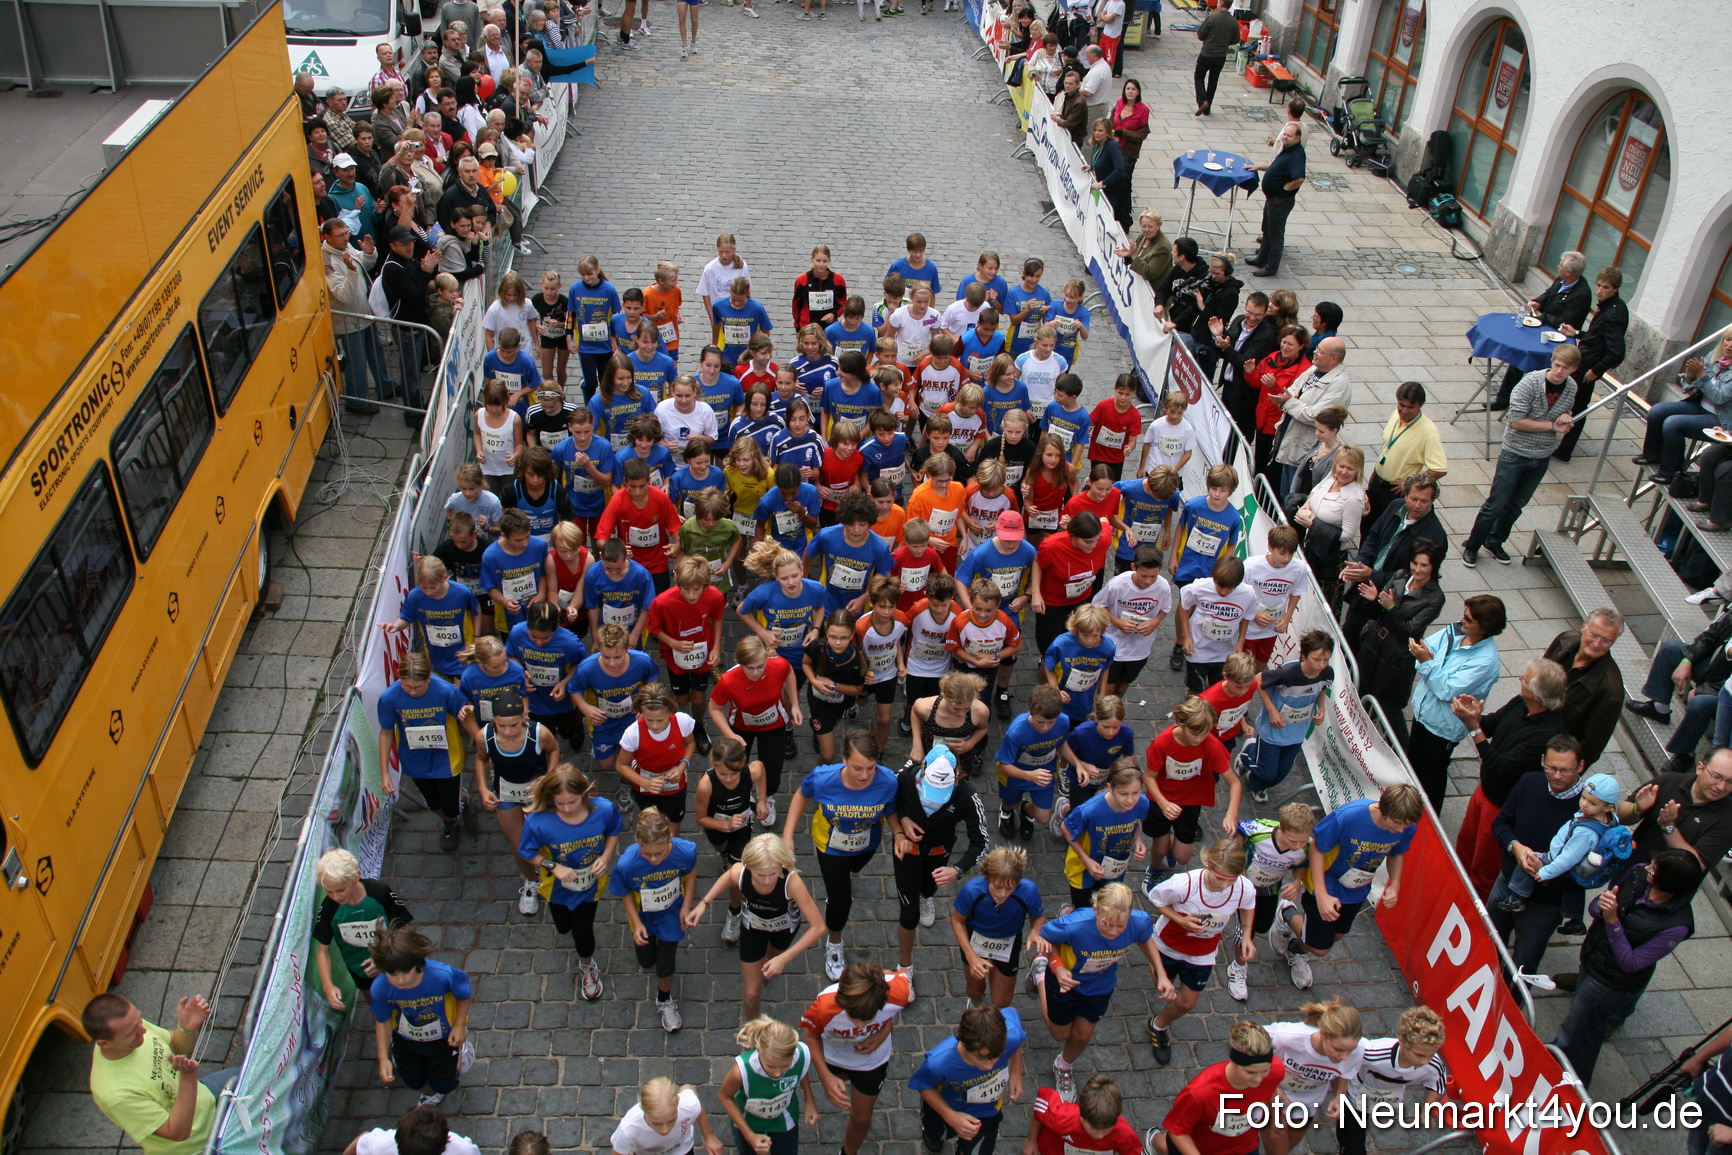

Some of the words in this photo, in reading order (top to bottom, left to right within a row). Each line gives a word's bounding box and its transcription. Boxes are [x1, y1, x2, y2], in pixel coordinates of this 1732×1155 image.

[1623, 161, 1640, 177] NEU
[1620, 172, 1636, 186] MARKT
[207, 208, 235, 254] EVENT
[234, 164, 265, 217] SERVICE
[120, 343, 134, 362] Fon:
[31, 373, 111, 496] SPORTRONIC
[40, 463, 71, 511] ELECTRONIC
[71, 436, 89, 465] SPORTS
[89, 397, 114, 438] EQUIPMENT
[637, 533, 657, 542] 4074
[1196, 540, 1215, 550] 4124
[512, 582, 533, 593] 4046
[1254, 580, 1288, 589] GERHART
[1117, 599, 1152, 608] GERHART
[1200, 602, 1234, 612] GERHART
[777, 606, 813, 615] NEUMARKTER
[780, 632, 802, 641] 4030
[684, 652, 706, 662] 4043
[1363, 740, 1373, 752] 52
[1174, 766, 1198, 775] 4041
[837, 804, 885, 813] NEUMARKTER
[842, 837, 867, 845] 4167
[654, 887, 677, 903] 4084
[355, 930, 376, 939] 410
[982, 941, 1009, 951] 4087
[408, 1029, 437, 1037] 4018
[150, 1036, 159, 1081] NEUMARKTER
[1286, 1058, 1331, 1078] GERHART
[980, 1079, 1006, 1098] 4106
[758, 1100, 787, 1113] 4143
